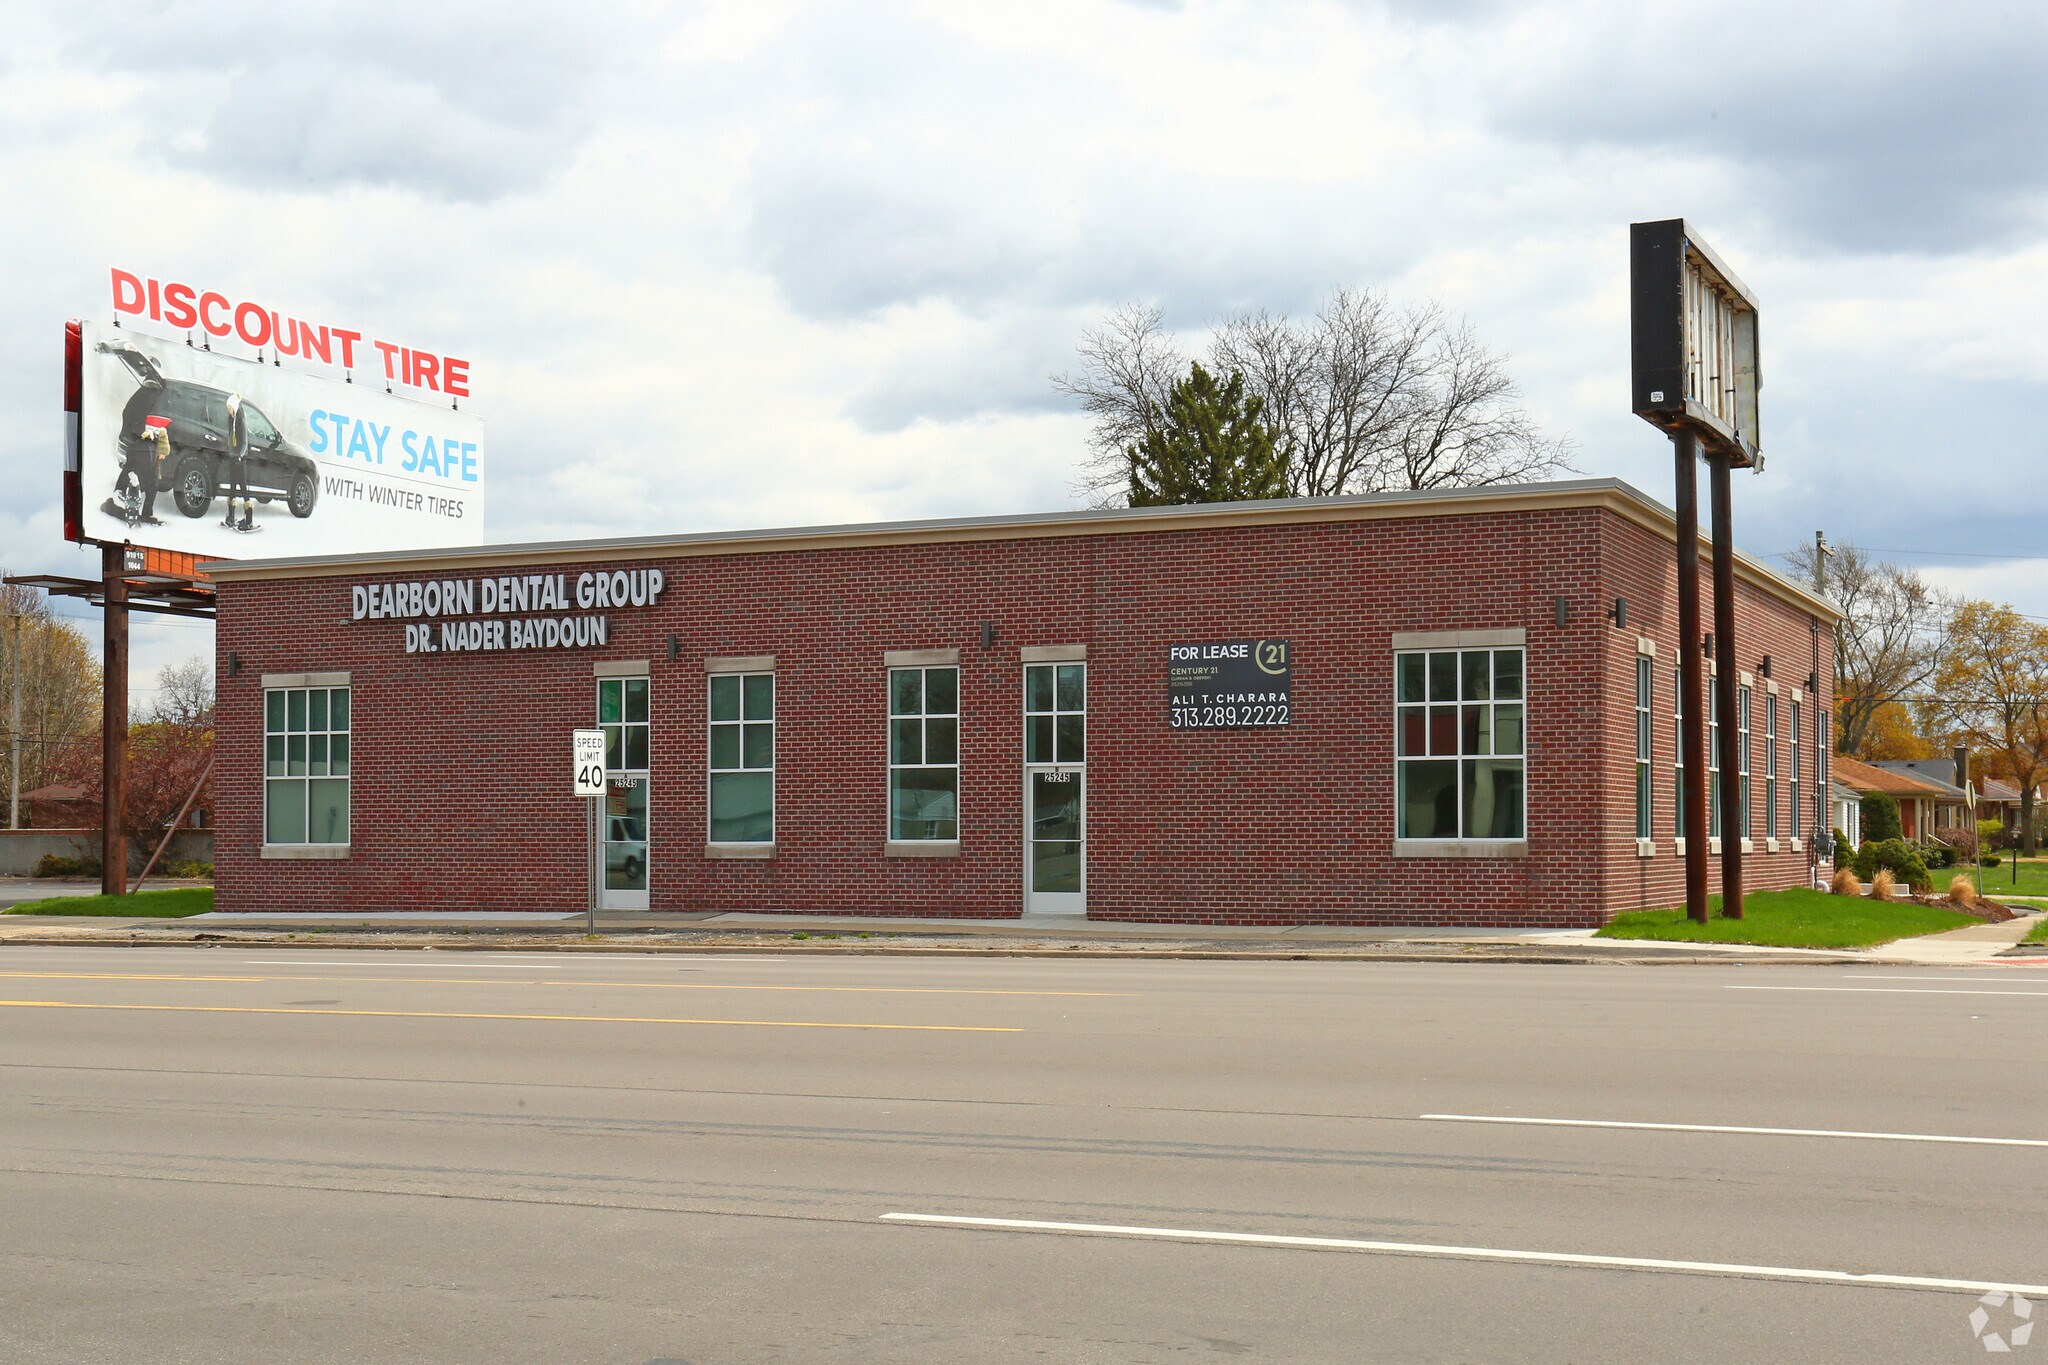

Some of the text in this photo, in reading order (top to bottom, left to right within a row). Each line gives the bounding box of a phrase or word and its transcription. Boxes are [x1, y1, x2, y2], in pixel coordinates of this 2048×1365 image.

[109, 265, 470, 399] DISCOUNT TIRE
[309, 409, 478, 482] STAY SAFE
[325, 476, 464, 519] WITH WINTER TIRES
[352, 568, 666, 620] DEARBORN DENTAL GROUP
[405, 615, 606, 653] DR. NADER BAYDOUN
[1170, 644, 1249, 661] FOR LEASE
[1170, 666, 1219, 675] CENTURY 21
[1172, 692, 1288, 705] ALI T. CHARARA
[1171, 705, 1289, 728] 313.289.2222
[577, 738, 603, 748] SPEED
[580, 752, 600, 761] LIMIT
[578, 765, 603, 788] 40
[615, 778, 637, 788] 25245
[1045, 773, 1069, 782] 25245
